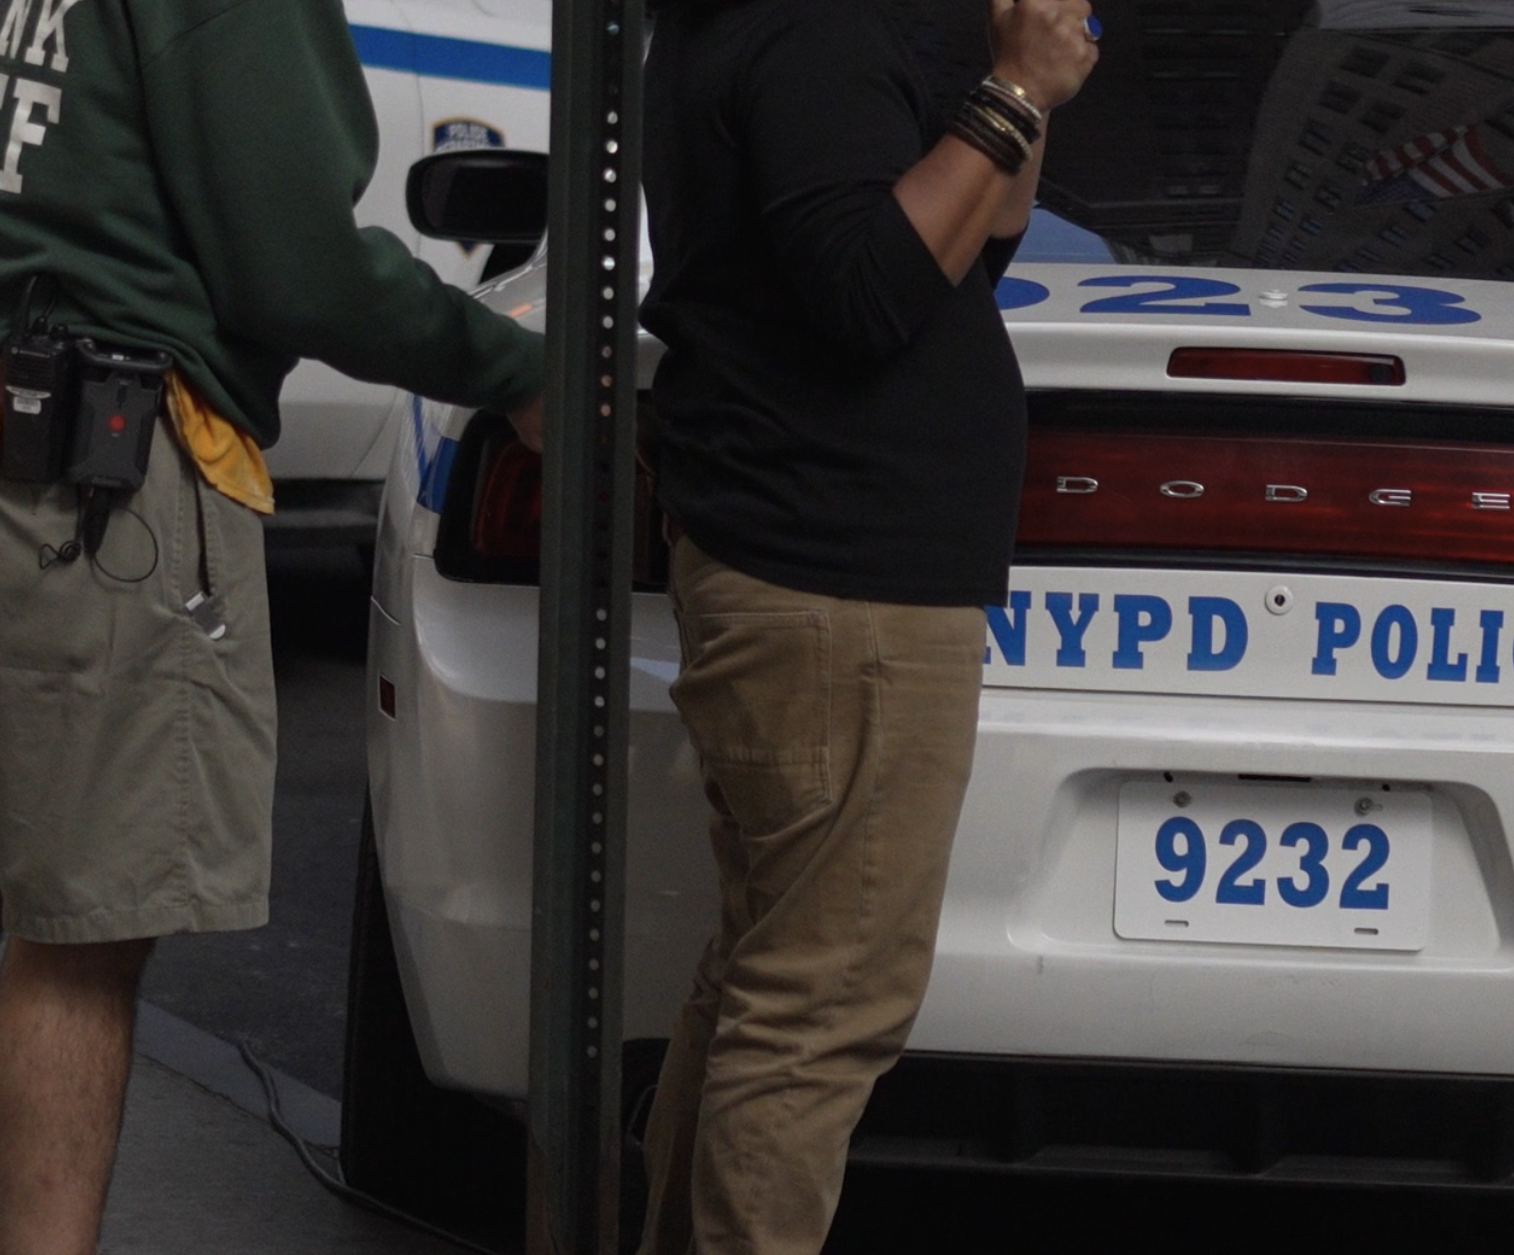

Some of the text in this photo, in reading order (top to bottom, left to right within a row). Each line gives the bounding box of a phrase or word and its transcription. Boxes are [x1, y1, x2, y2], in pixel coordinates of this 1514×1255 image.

[1055, 476, 1511, 510] DODGE
[982, 589, 1250, 673] NYPD
[1153, 816, 1392, 910] 9232
